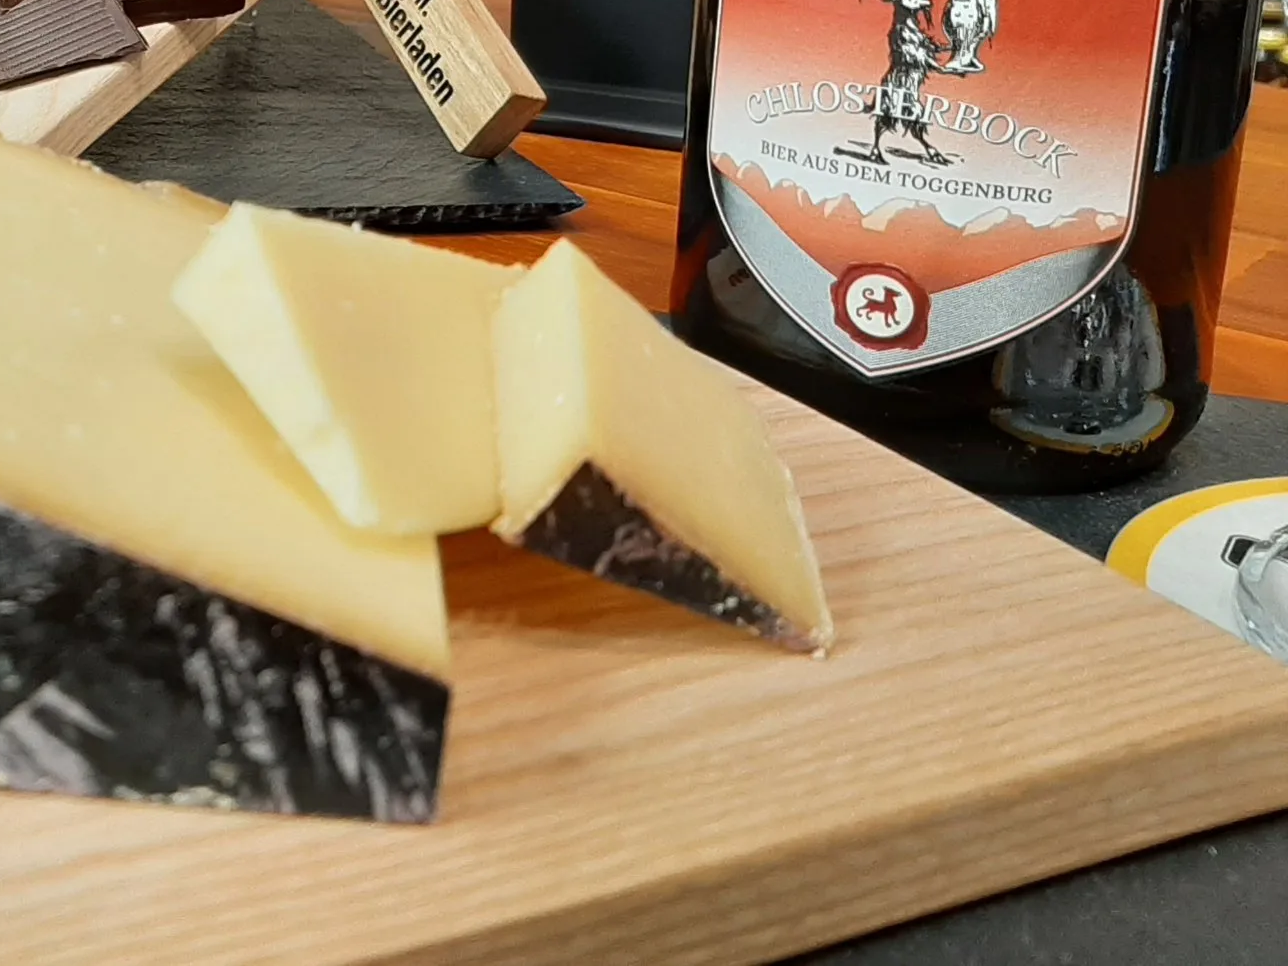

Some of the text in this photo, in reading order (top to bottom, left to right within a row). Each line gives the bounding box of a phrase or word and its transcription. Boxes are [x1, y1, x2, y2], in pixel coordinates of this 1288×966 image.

[745, 80, 1079, 180] CHLOSTERBOCK
[760, 139, 1054, 205] BIER AUS DEM TOGGENBURG
